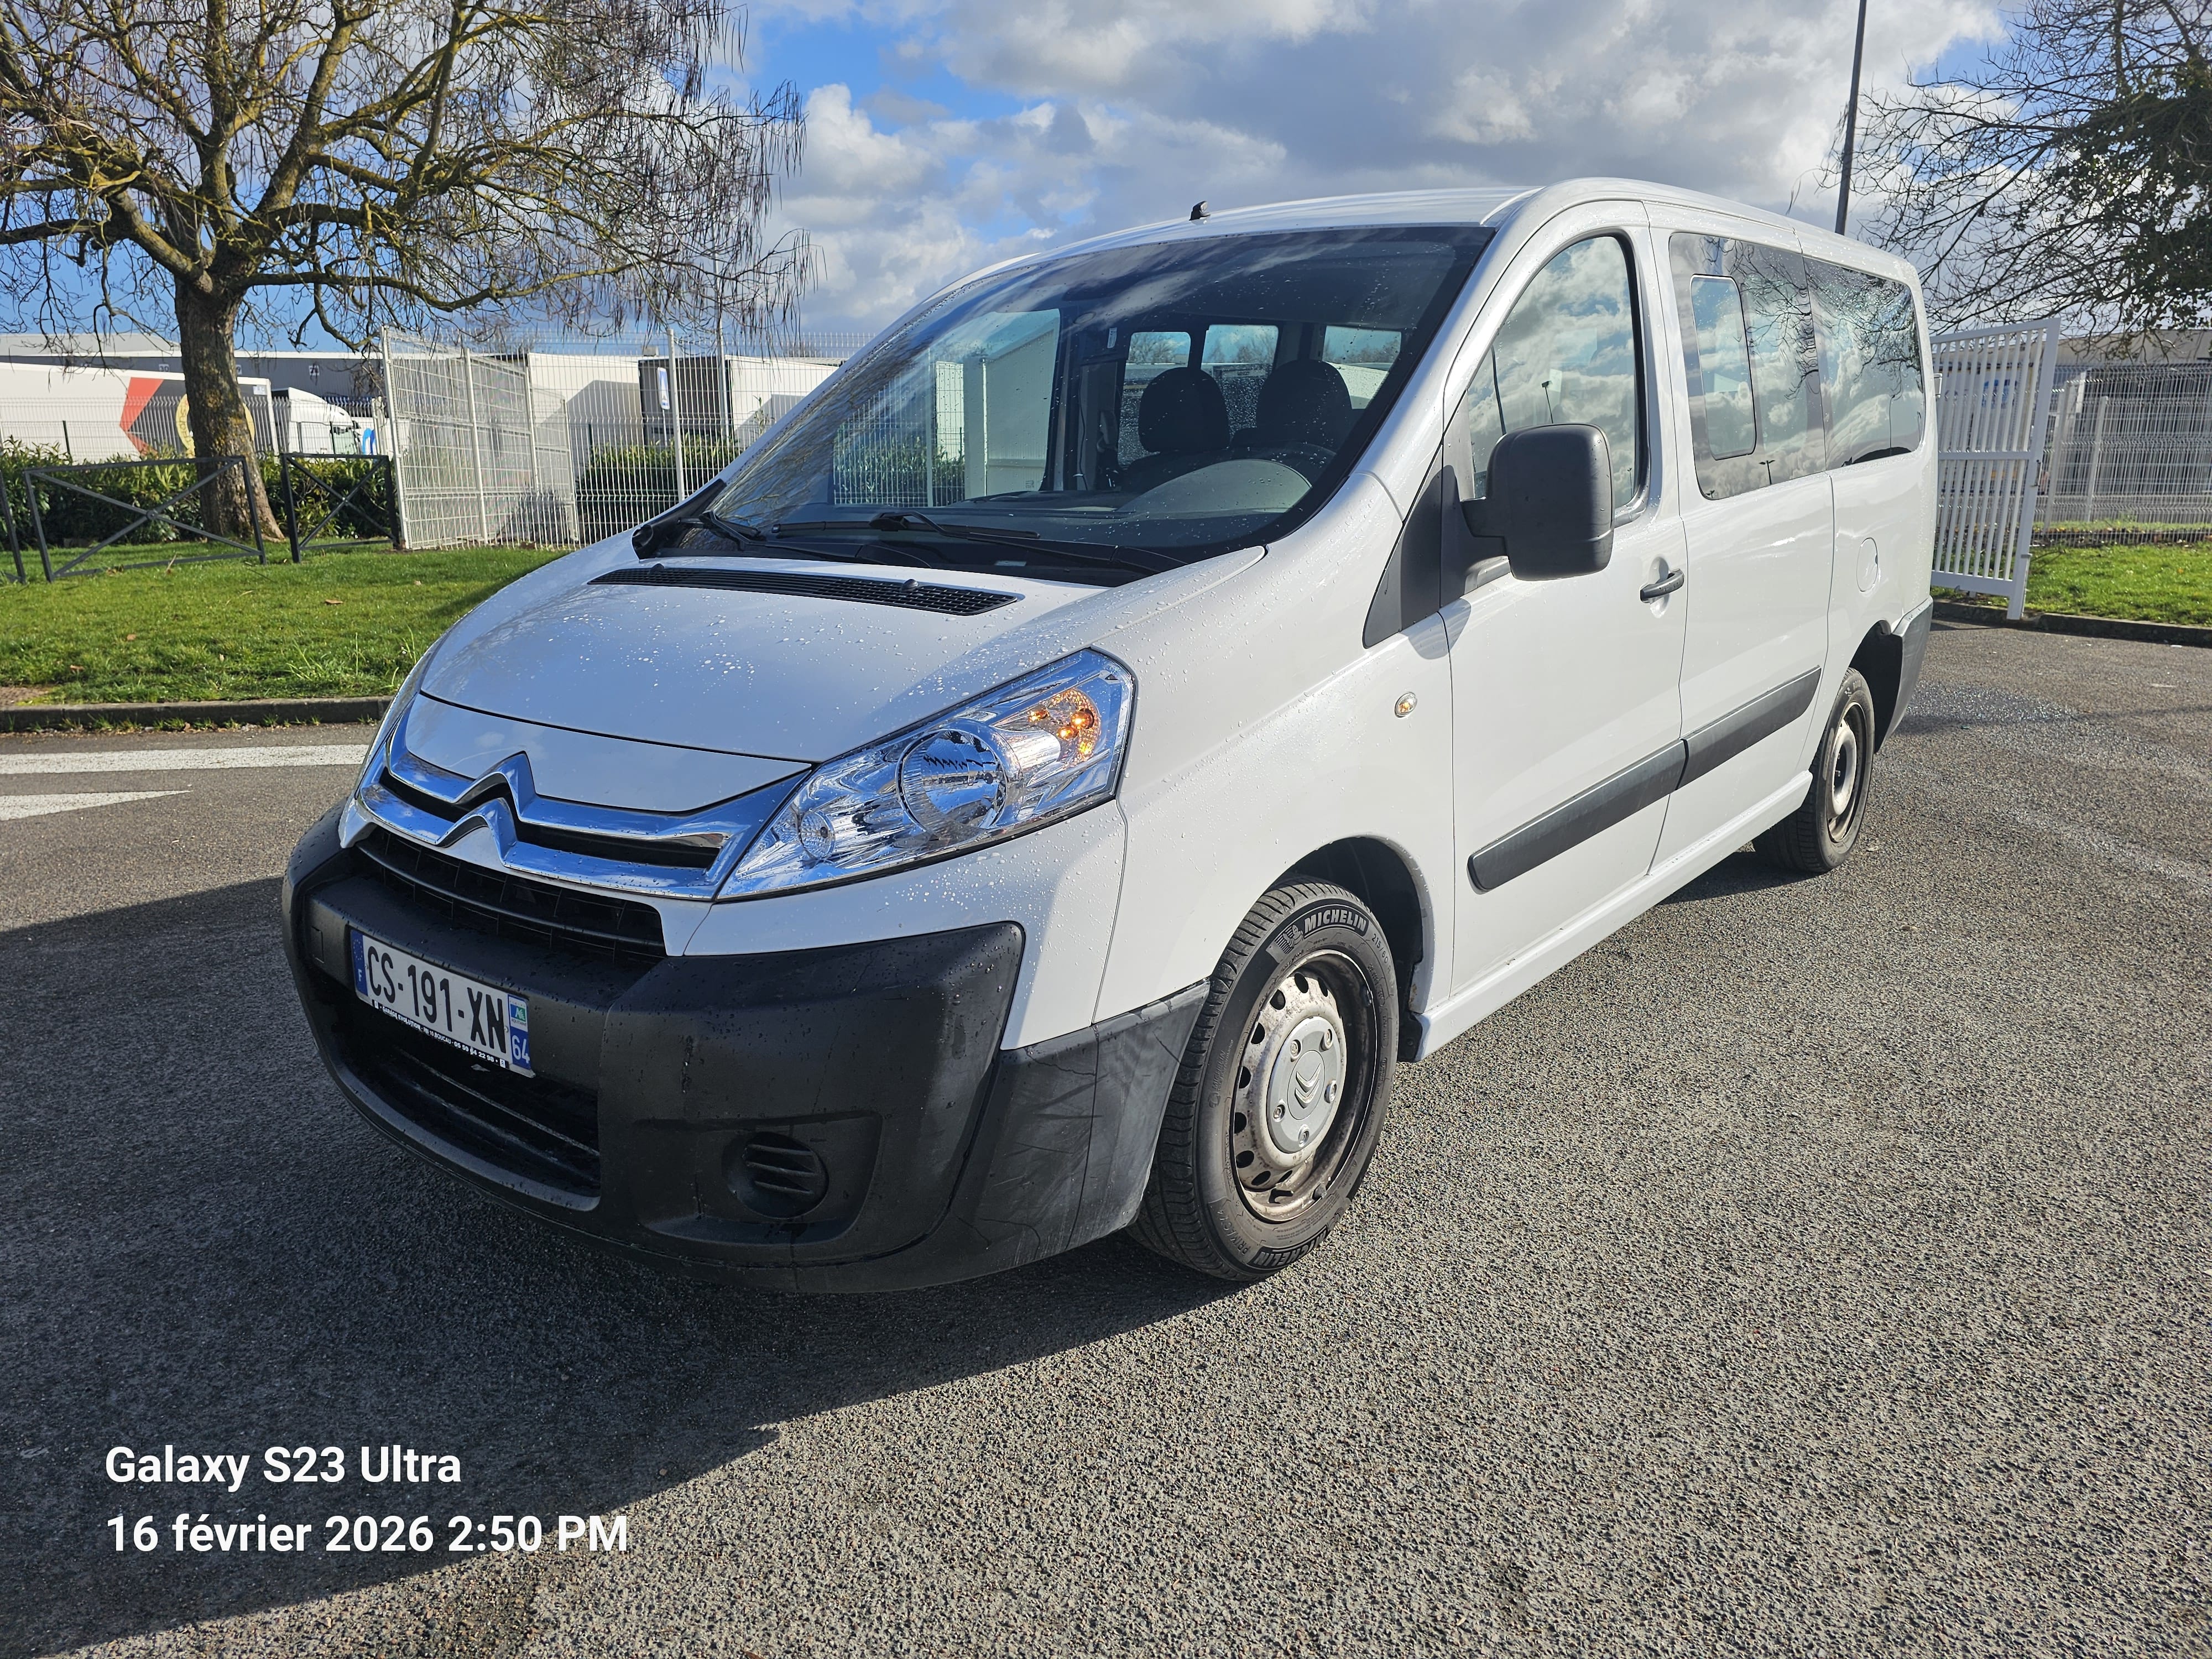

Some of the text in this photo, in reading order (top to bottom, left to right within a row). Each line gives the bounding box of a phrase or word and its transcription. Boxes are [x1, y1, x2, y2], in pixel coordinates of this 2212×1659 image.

[1305, 909, 1366, 933] MICHELIN
[1372, 933, 1389, 963] 215/60
[358, 968, 363, 982] F
[368, 946, 507, 1053] CS-191-XN
[512, 1035, 530, 1064] 64
[1212, 1050, 1226, 1089] MICHELIN
